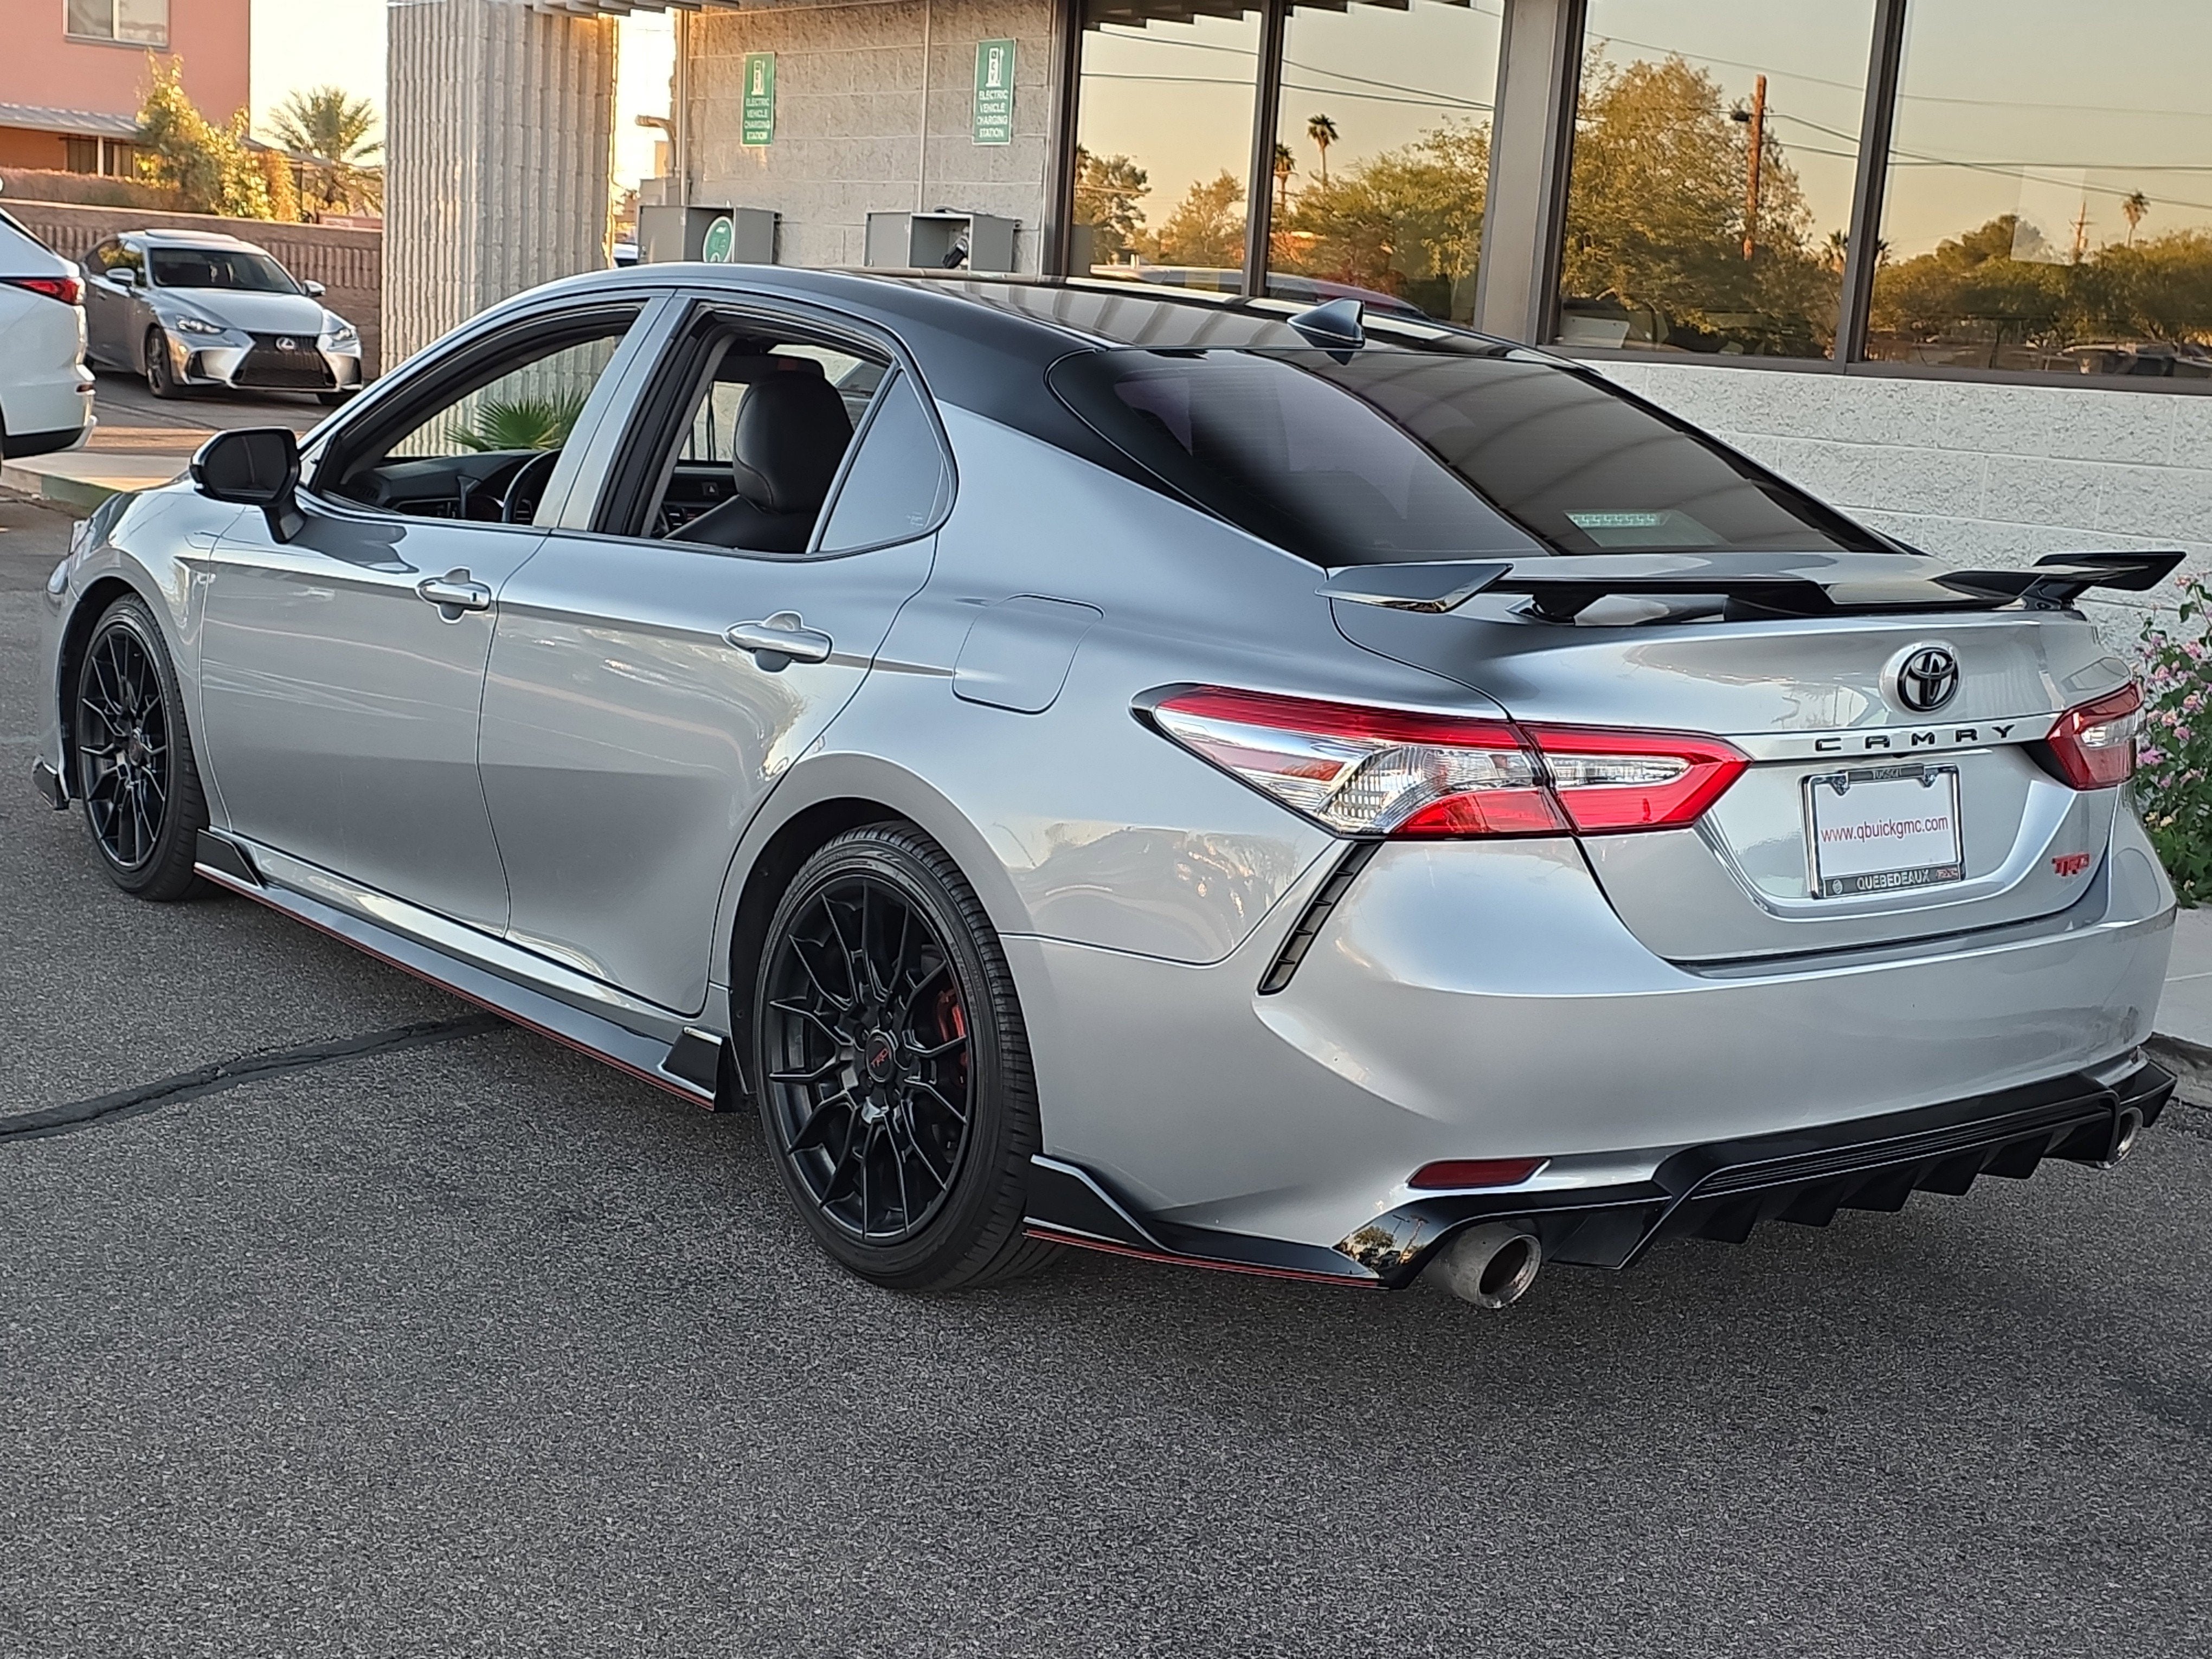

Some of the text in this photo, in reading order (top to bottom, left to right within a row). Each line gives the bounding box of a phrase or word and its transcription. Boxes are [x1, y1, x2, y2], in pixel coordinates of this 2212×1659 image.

[978, 89, 1009, 100] ELECTRIC
[745, 98, 770, 107] ELECTRIC
[979, 102, 1006, 113] VEHICLE
[976, 115, 1008, 125] CHARGING
[979, 127, 1004, 138] STATION
[1815, 724, 2015, 752] CAMRY
[1821, 816, 1949, 843] www.qbuickgmc.com
[1856, 869, 1931, 891] QUEBEDEAUX
